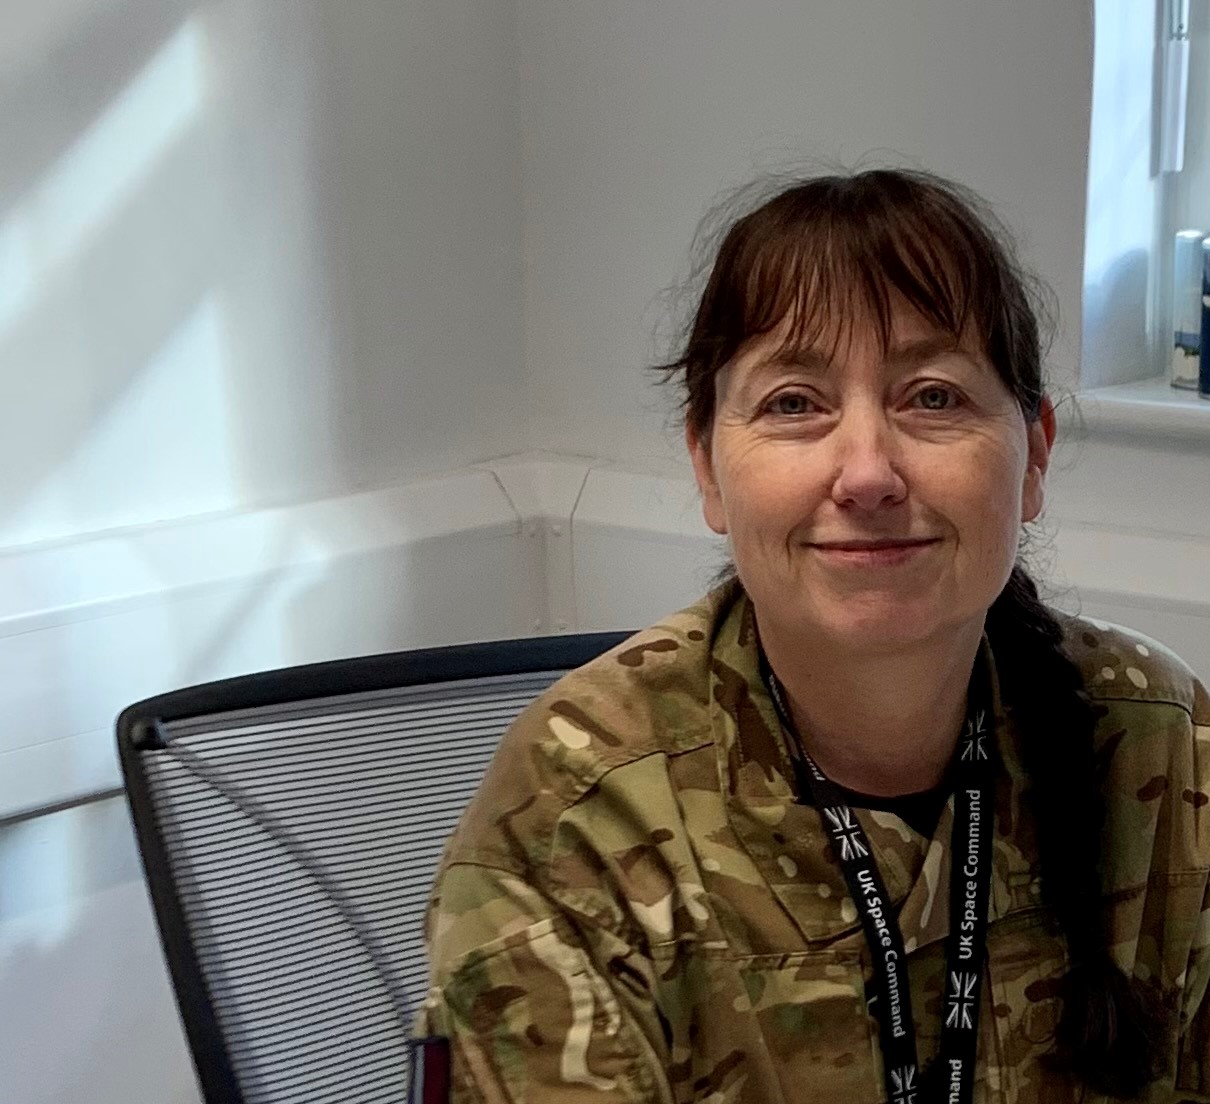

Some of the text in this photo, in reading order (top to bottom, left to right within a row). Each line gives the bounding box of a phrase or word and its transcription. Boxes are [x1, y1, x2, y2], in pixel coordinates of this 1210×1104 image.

[856, 869, 906, 1037] UK Space Command
[959, 789, 981, 960] UK Space Command
